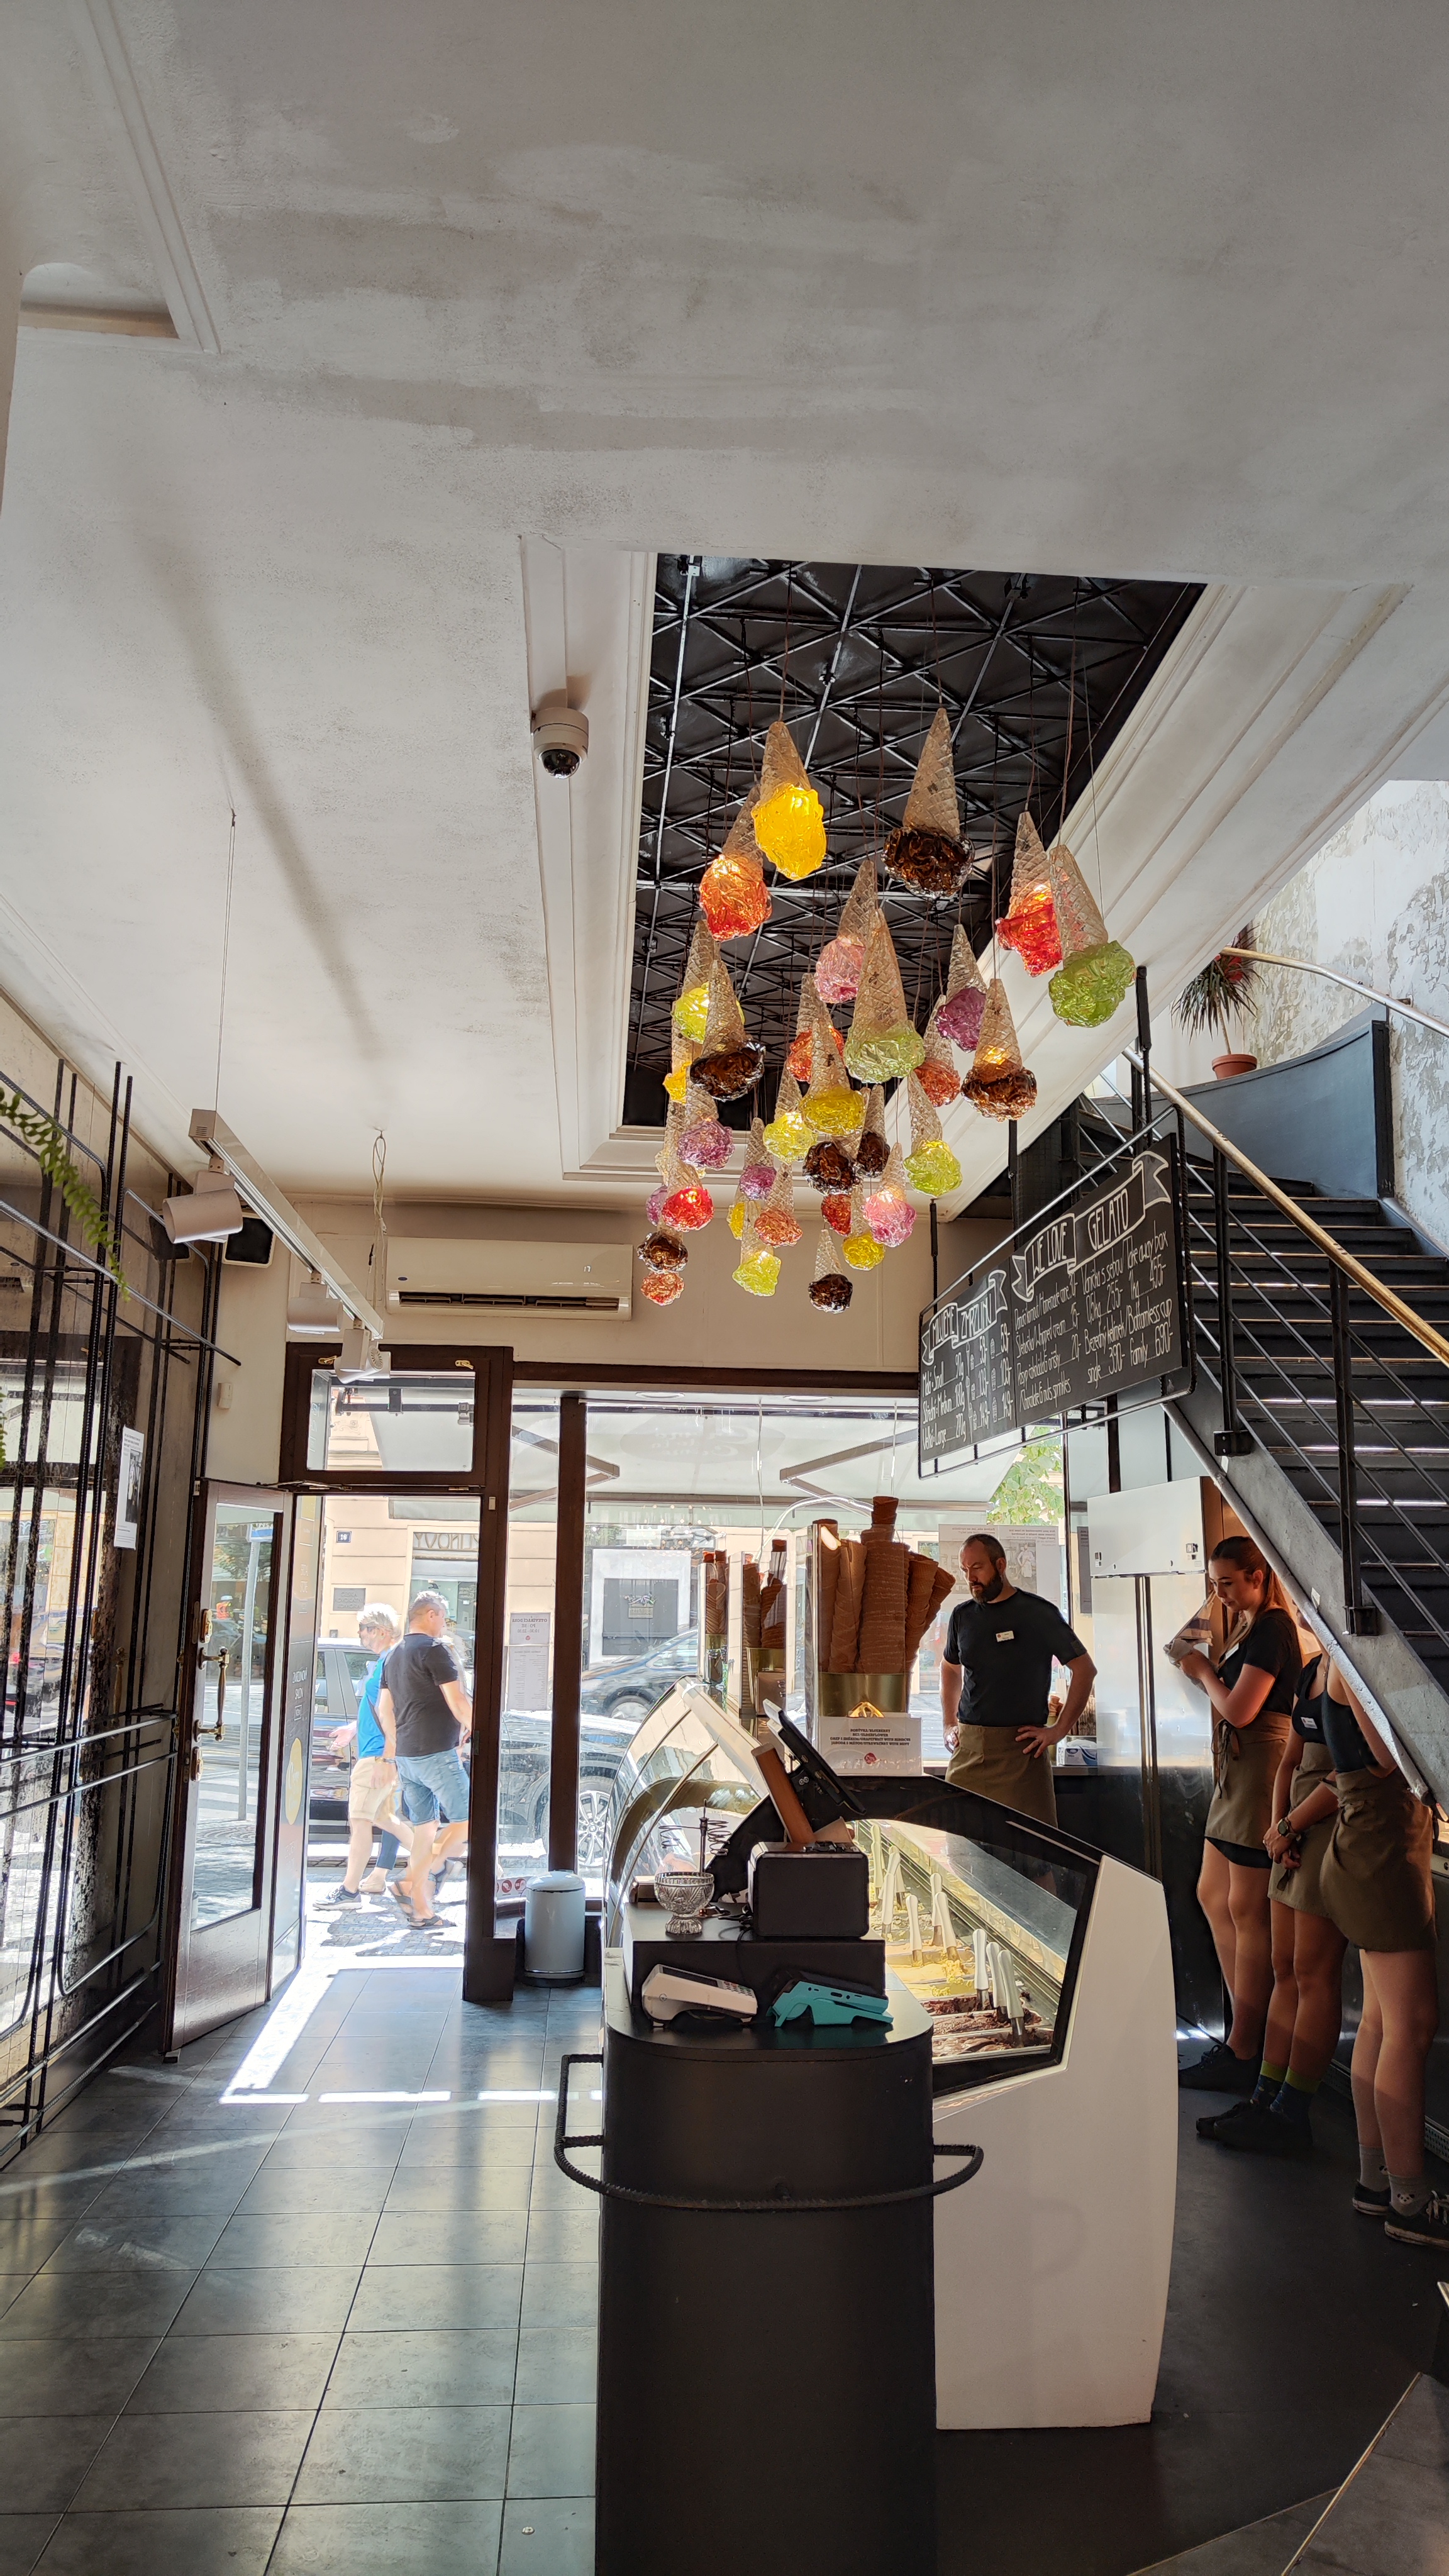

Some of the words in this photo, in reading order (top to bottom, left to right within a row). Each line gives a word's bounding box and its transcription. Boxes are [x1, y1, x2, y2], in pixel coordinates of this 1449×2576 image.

[1031, 1237, 1045, 1279] WE
[1046, 1221, 1067, 1270] LOVE
[1087, 1188, 1129, 1250] GELATO
[1153, 1219, 1168, 1253] box
[960, 1293, 992, 1340] ZMRZLINU
[1159, 1298, 1172, 1330] cup
[1087, 1351, 1101, 1389] single
[1130, 1332, 1148, 1368] family
